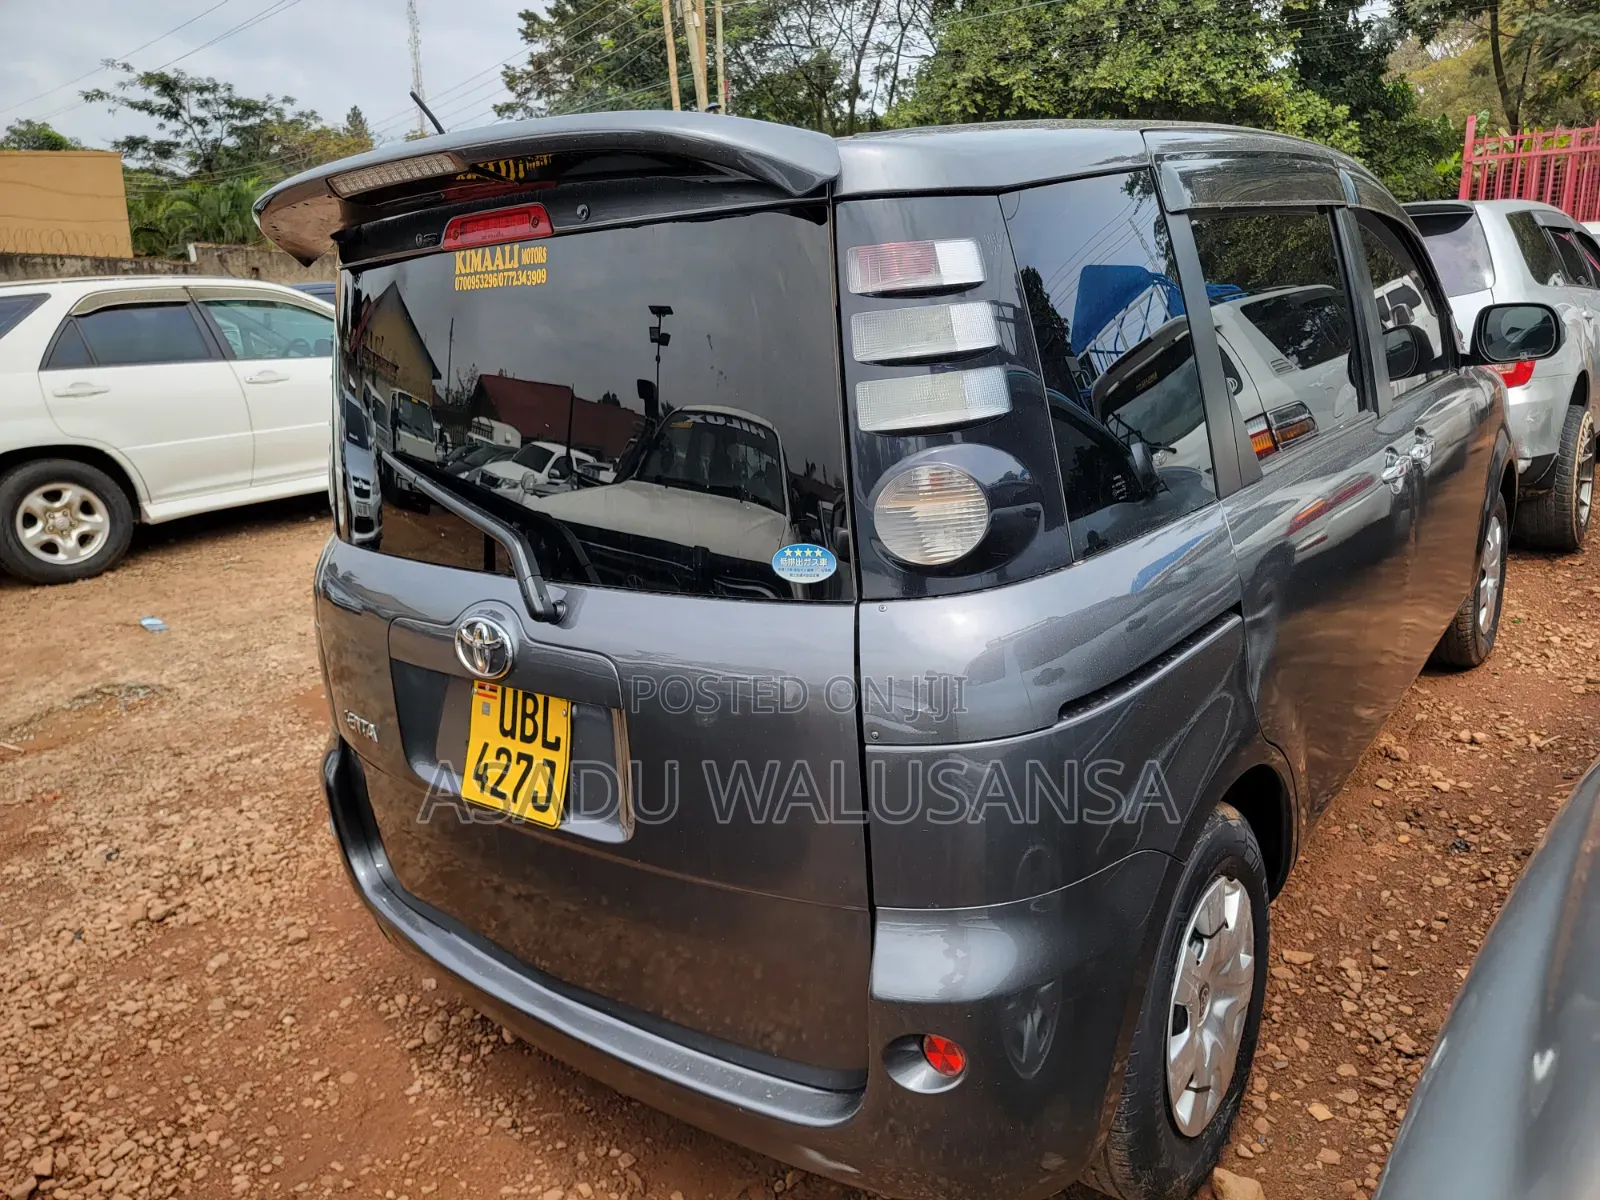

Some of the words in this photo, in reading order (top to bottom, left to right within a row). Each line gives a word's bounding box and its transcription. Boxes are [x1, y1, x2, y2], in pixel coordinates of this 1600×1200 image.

[455, 244, 519, 274] KIMAALI
[521, 246, 547, 265] MOTORS
[499, 687, 561, 751] UBL
[472, 741, 556, 813] 427J
